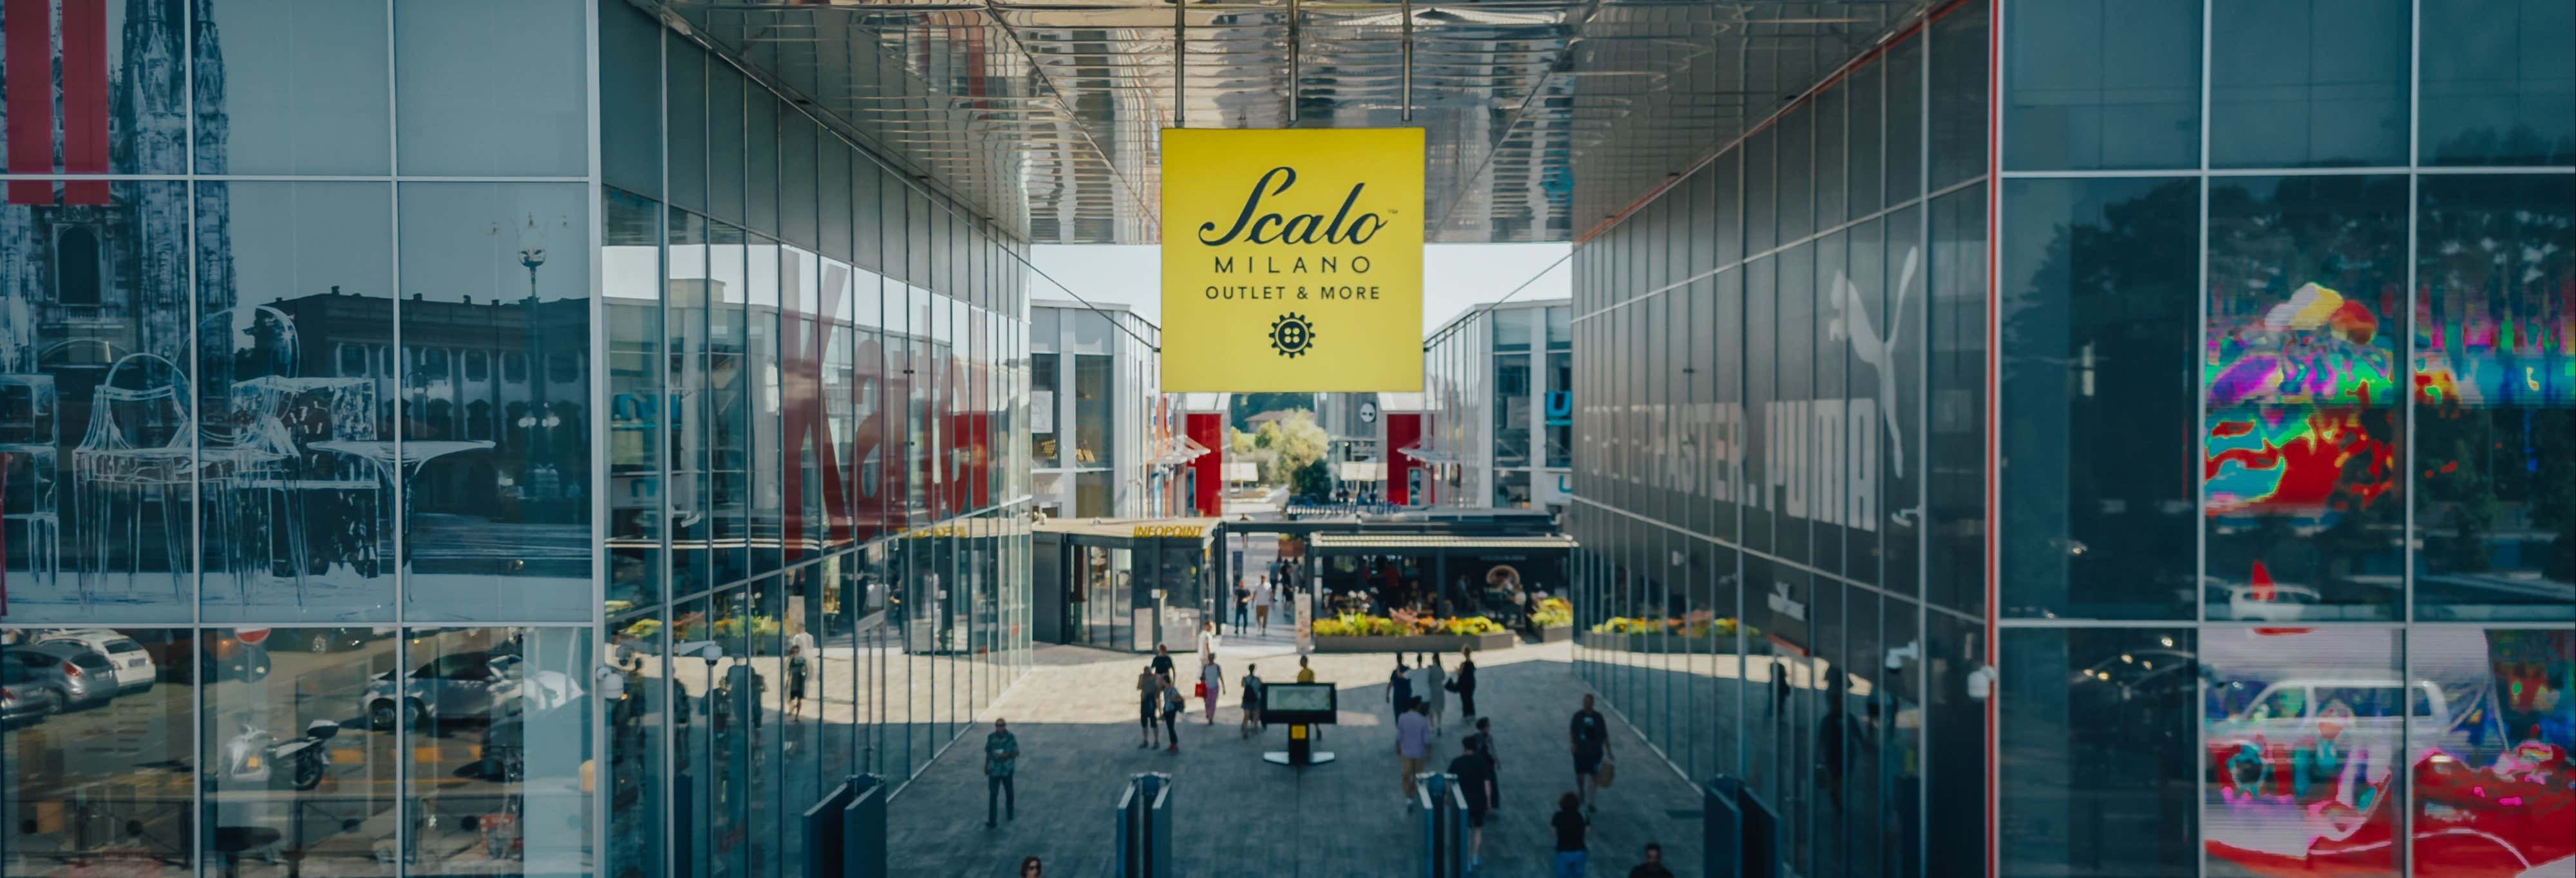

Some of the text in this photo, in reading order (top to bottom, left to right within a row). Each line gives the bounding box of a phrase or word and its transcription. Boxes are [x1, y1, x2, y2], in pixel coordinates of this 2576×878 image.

[1198, 166, 1388, 246] Scalo
[1215, 256, 1371, 274] MILANO
[1205, 286, 1380, 300] OUTLET & MORE
[1765, 398, 1876, 532] PUMA
[1133, 525, 1204, 538] INFOPOINT
